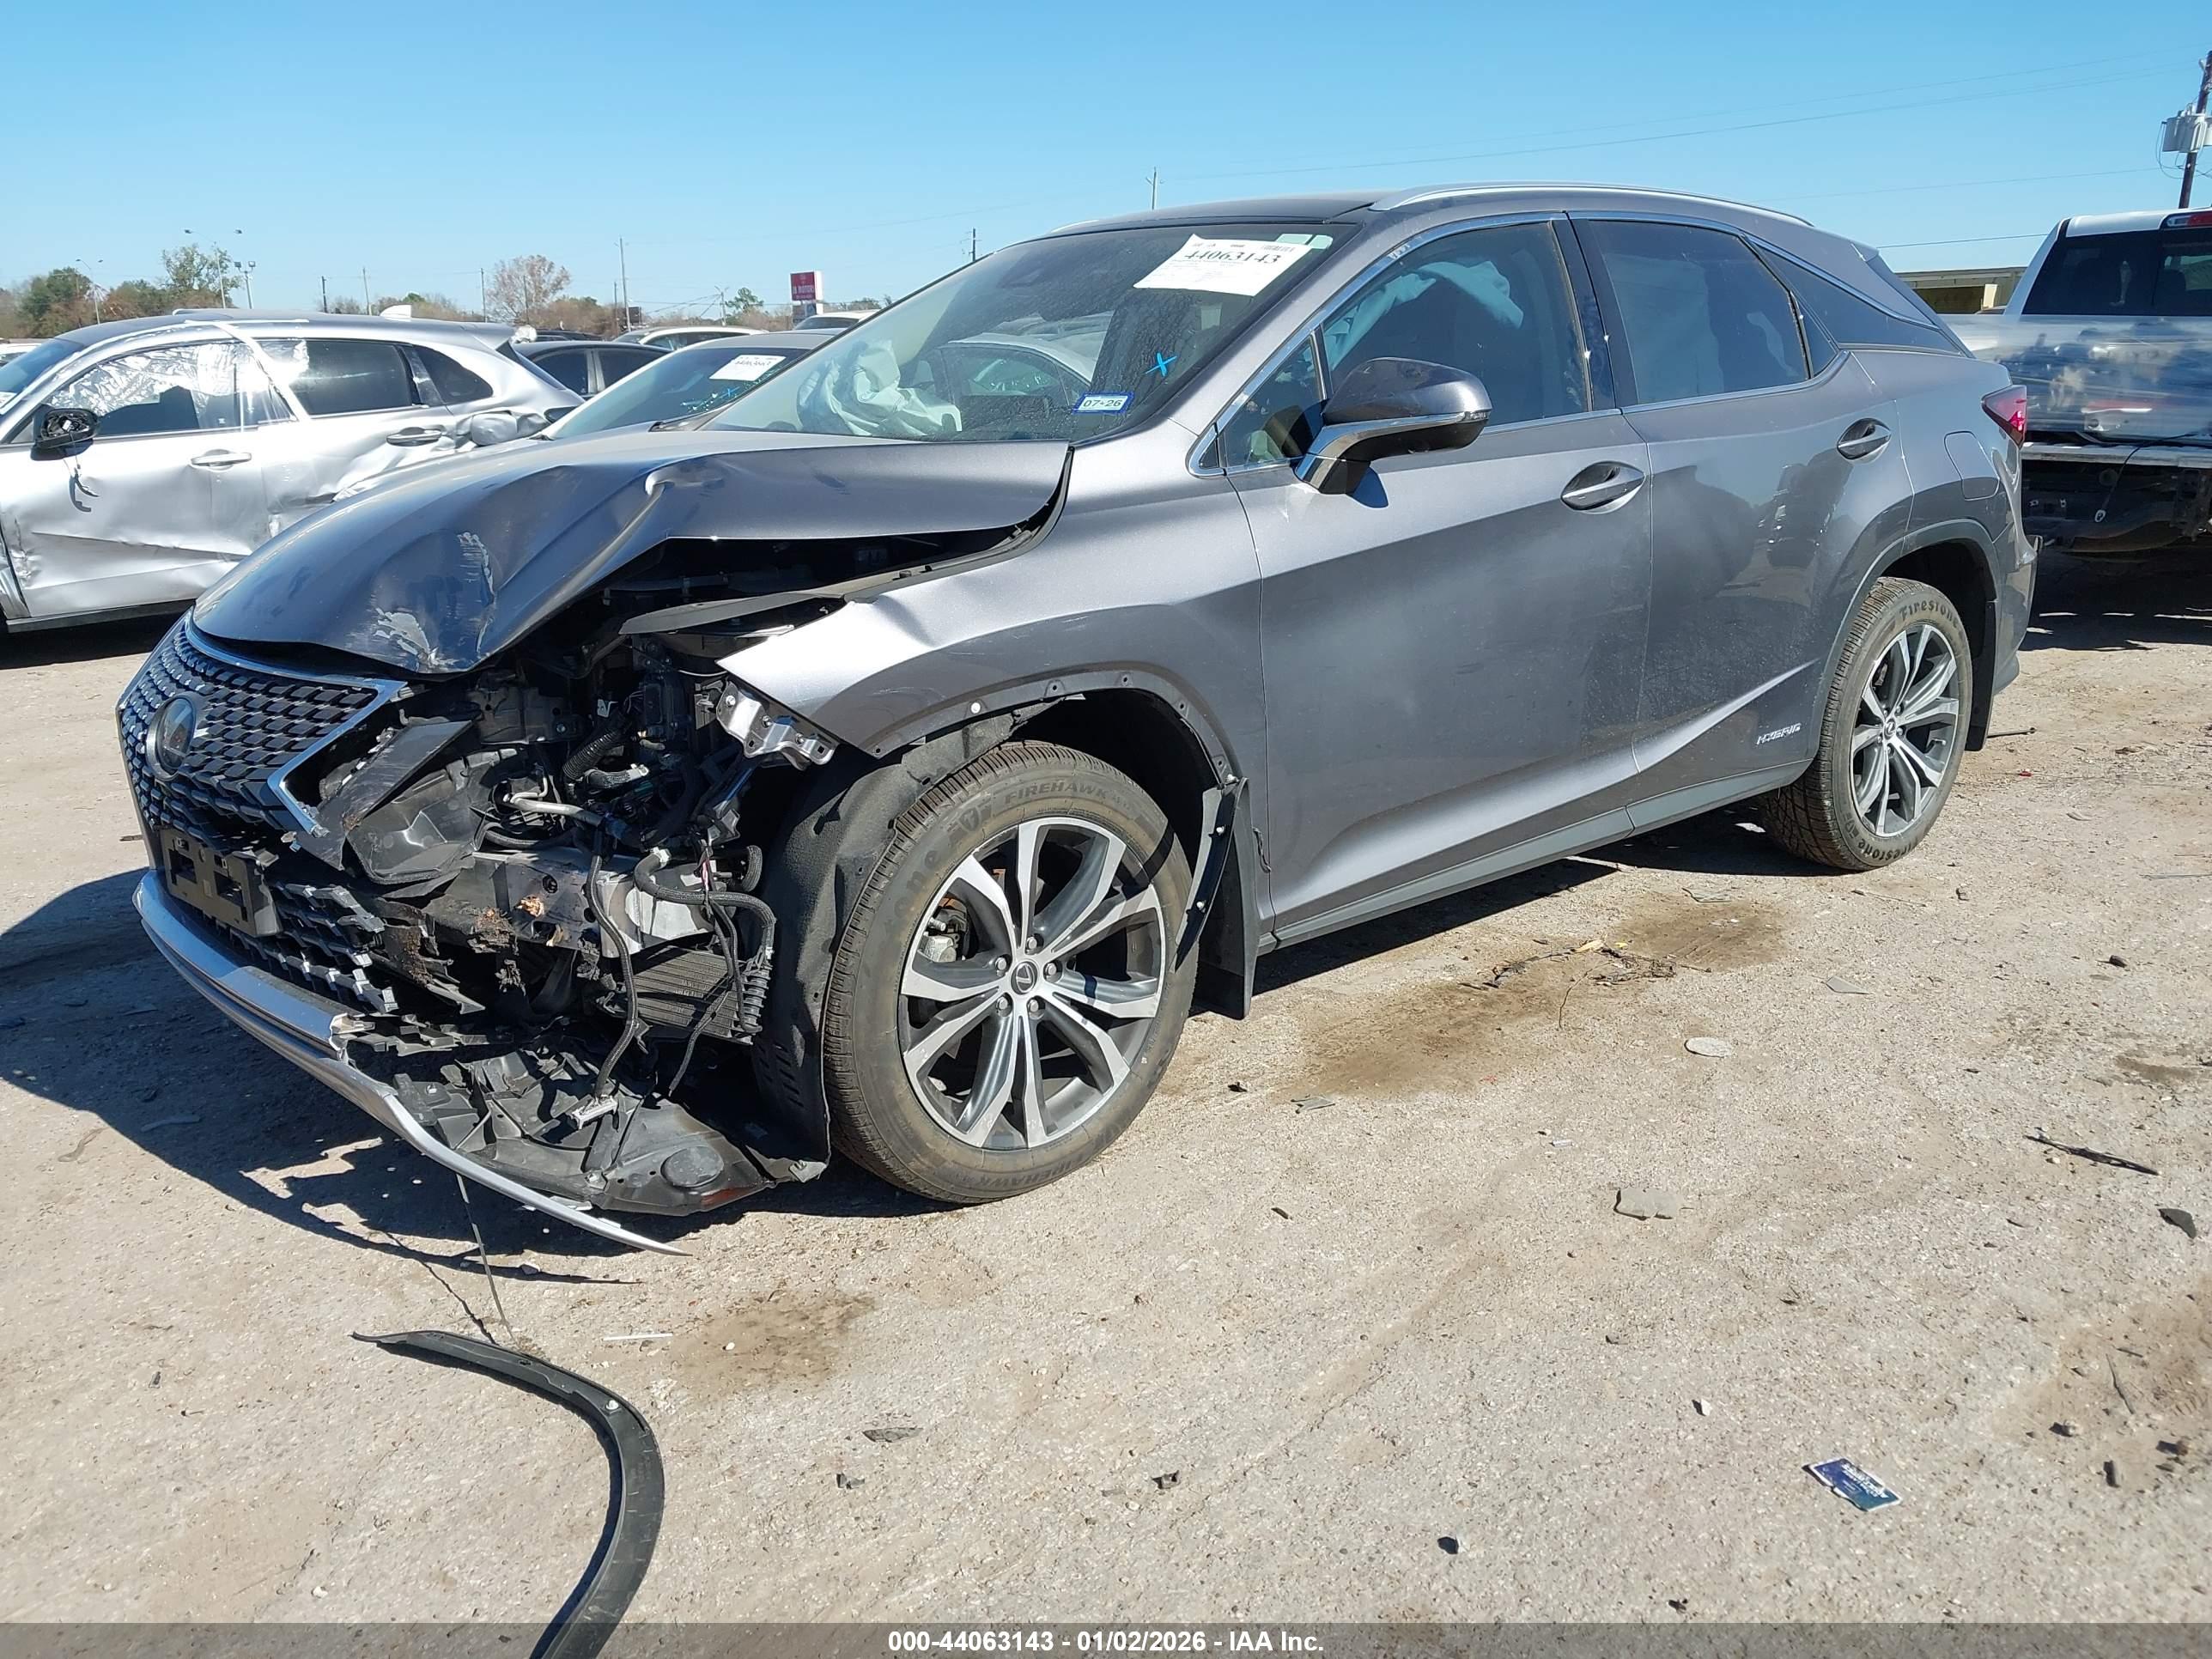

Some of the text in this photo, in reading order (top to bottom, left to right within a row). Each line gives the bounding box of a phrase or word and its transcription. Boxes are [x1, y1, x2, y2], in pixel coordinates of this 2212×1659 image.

[1184, 251, 1281, 264] 44063143
[1899, 600, 1958, 628] Firestone
[1003, 781, 1108, 805] FIREHAWK
